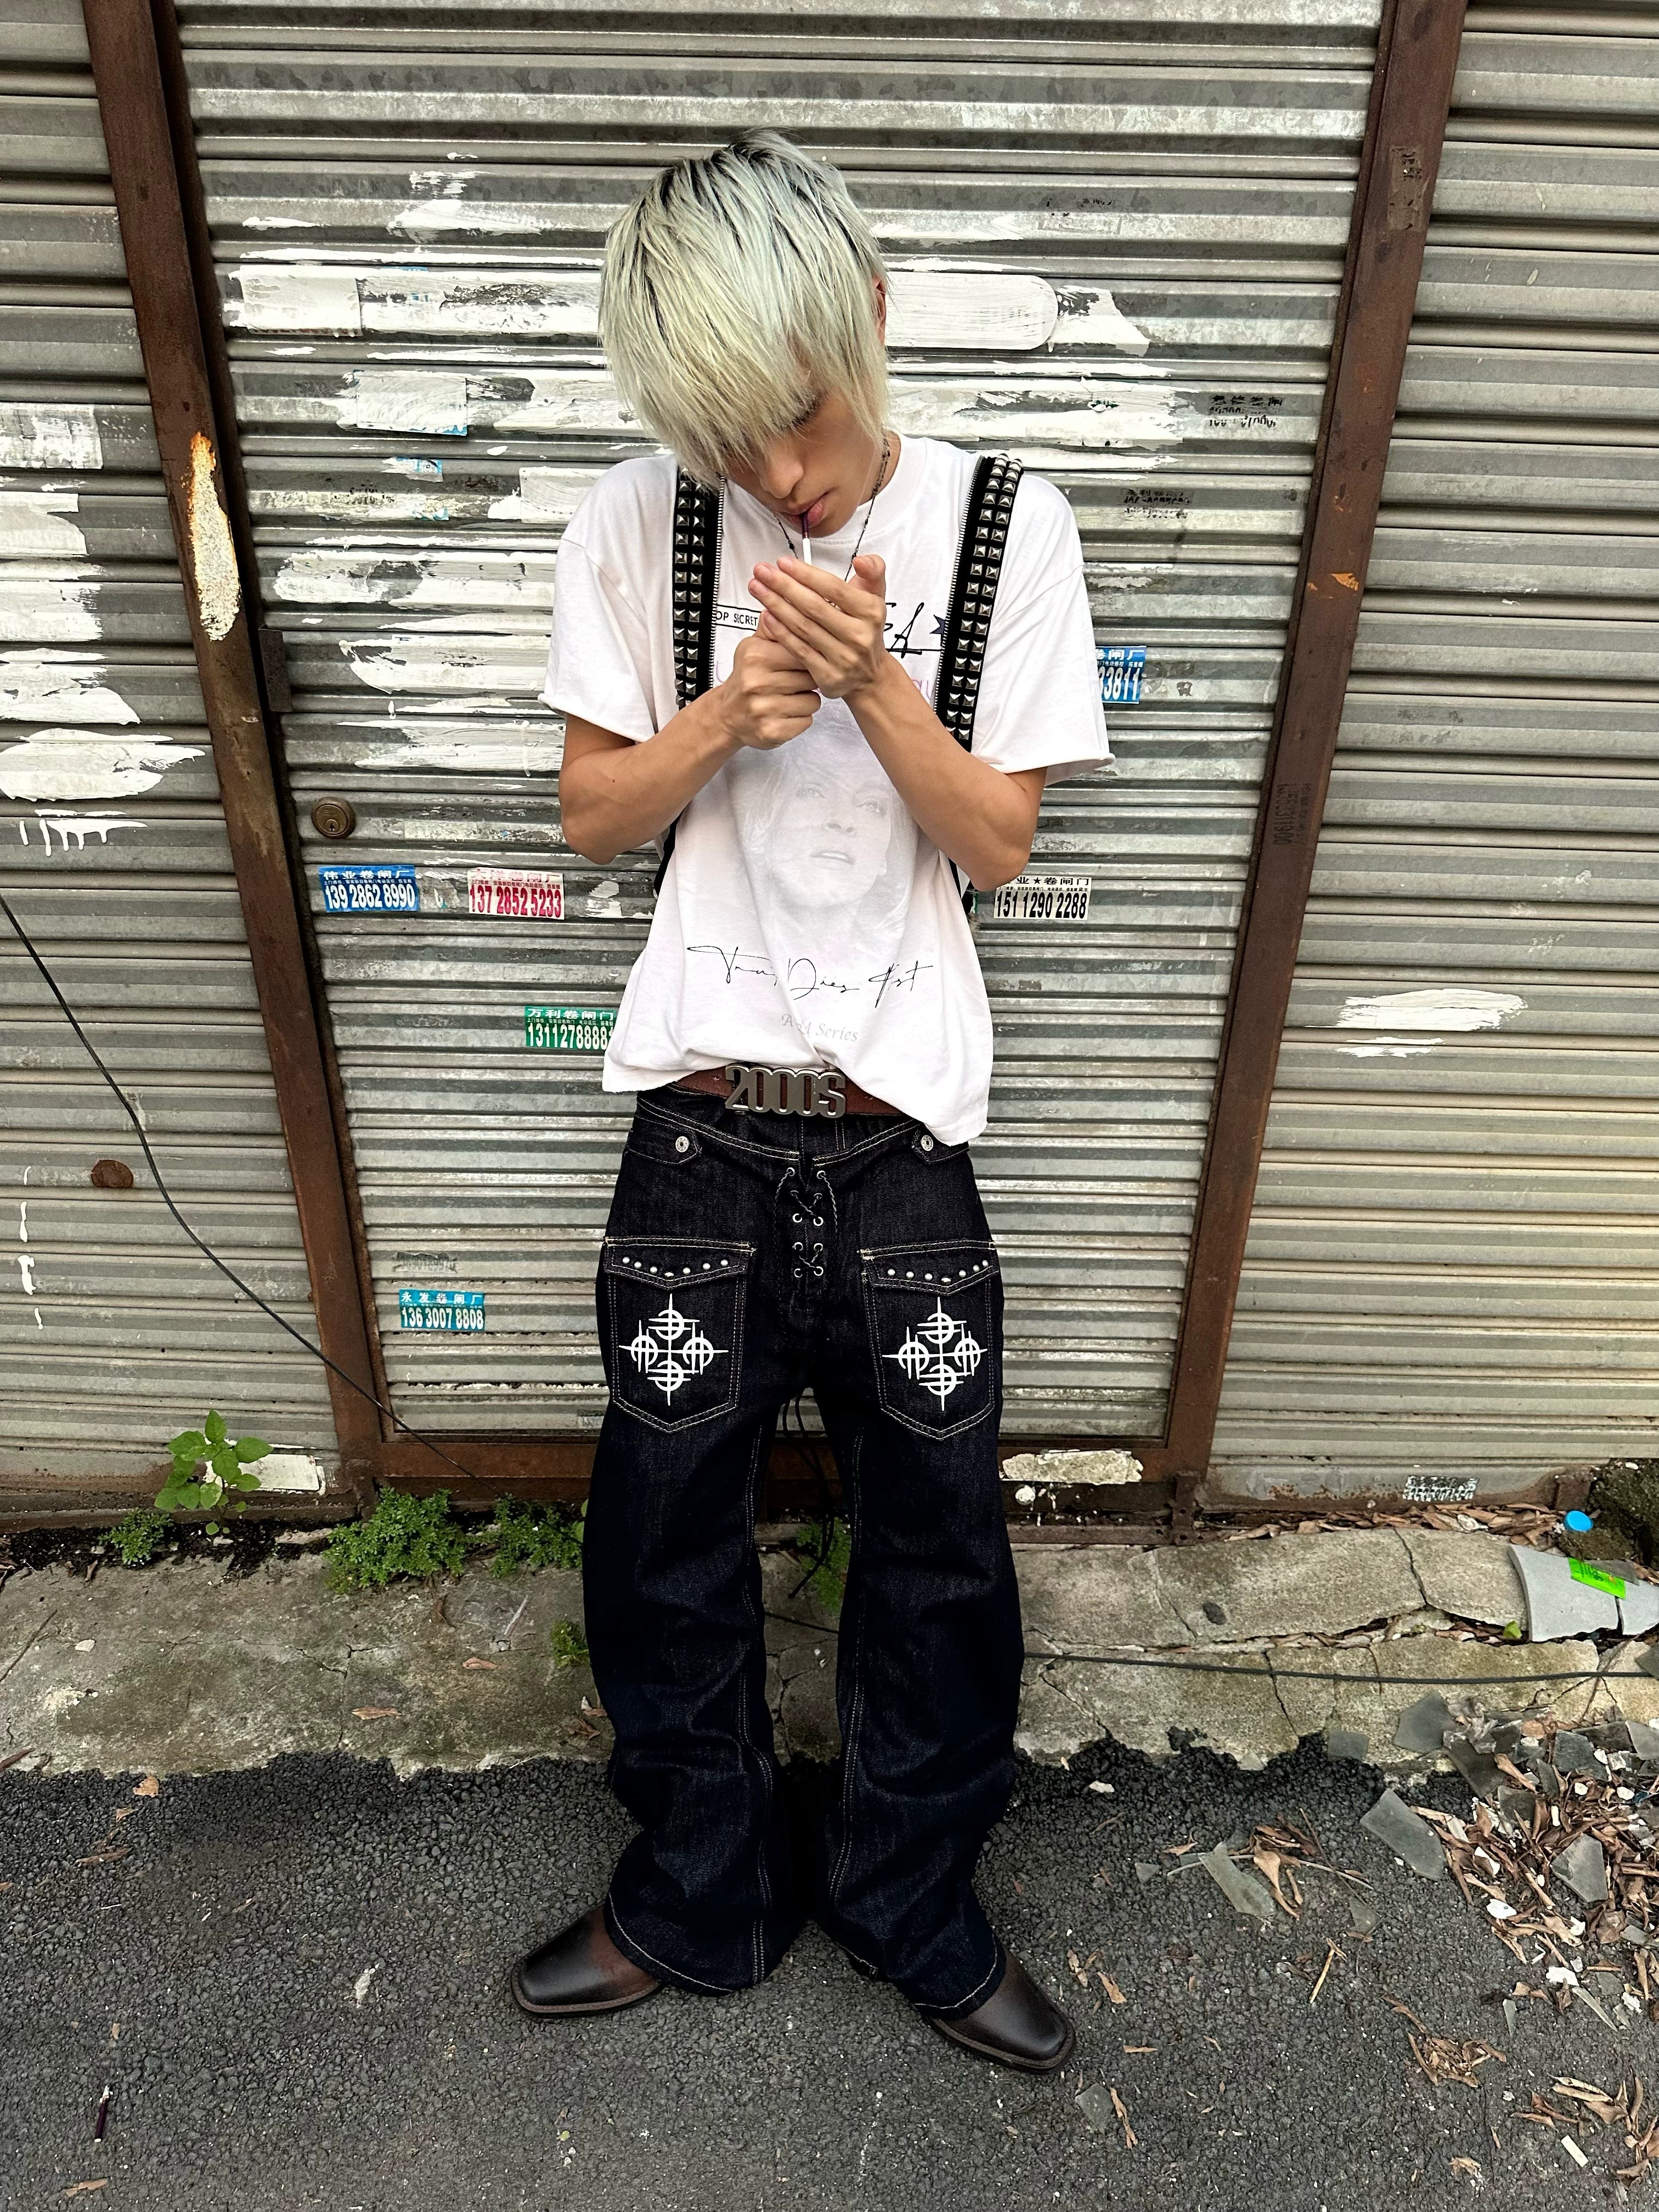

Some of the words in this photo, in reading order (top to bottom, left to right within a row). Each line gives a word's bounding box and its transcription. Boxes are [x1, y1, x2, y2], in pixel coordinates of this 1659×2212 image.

[716, 611, 729, 620] OP
[733, 613, 758, 627] SECRET
[323, 870, 410, 880] 伟业卷闸厂
[325, 884, 348, 909] 139
[349, 884, 383, 908] 2862
[382, 883, 415, 908] 8990
[470, 884, 493, 913] 137
[496, 886, 528, 916] 2852
[531, 888, 561, 918] 5233
[997, 891, 1019, 917] 151
[1023, 891, 1053, 918] 1290
[1055, 892, 1087, 919] 2288
[527, 1008, 614, 1020] 万利卷闸门
[816, 1023, 859, 1041] Series
[401, 1291, 482, 1305] 永发卷闸厂
[402, 1307, 424, 1328] 136
[425, 1307, 453, 1329] 3007
[455, 1308, 484, 1330] 8808
